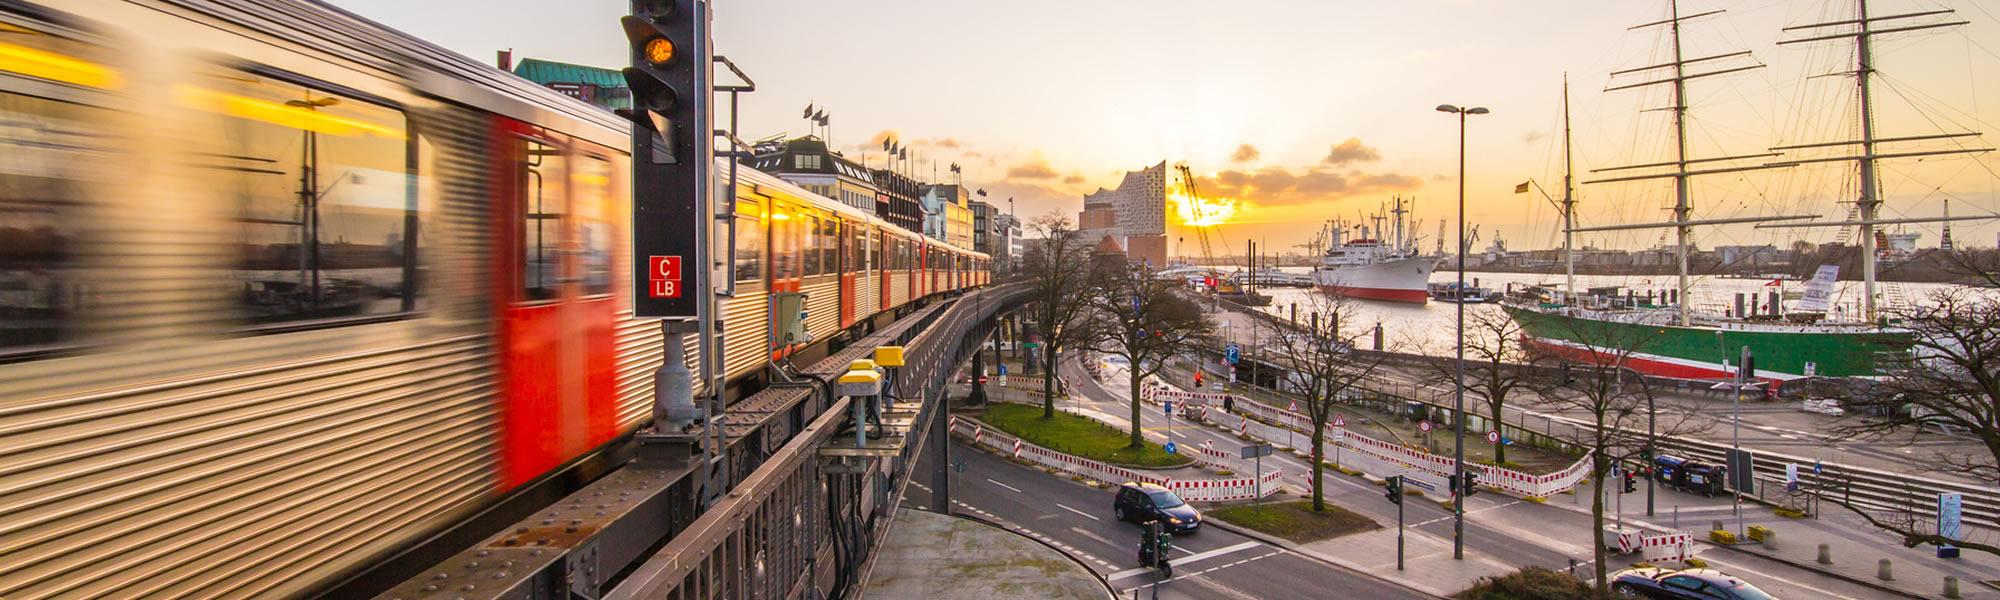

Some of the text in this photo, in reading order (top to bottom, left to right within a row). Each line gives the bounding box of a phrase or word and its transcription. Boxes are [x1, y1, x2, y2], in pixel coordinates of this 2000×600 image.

[660, 260, 670, 276] C
[656, 281, 674, 296] LB
[1229, 348, 1237, 357] P
